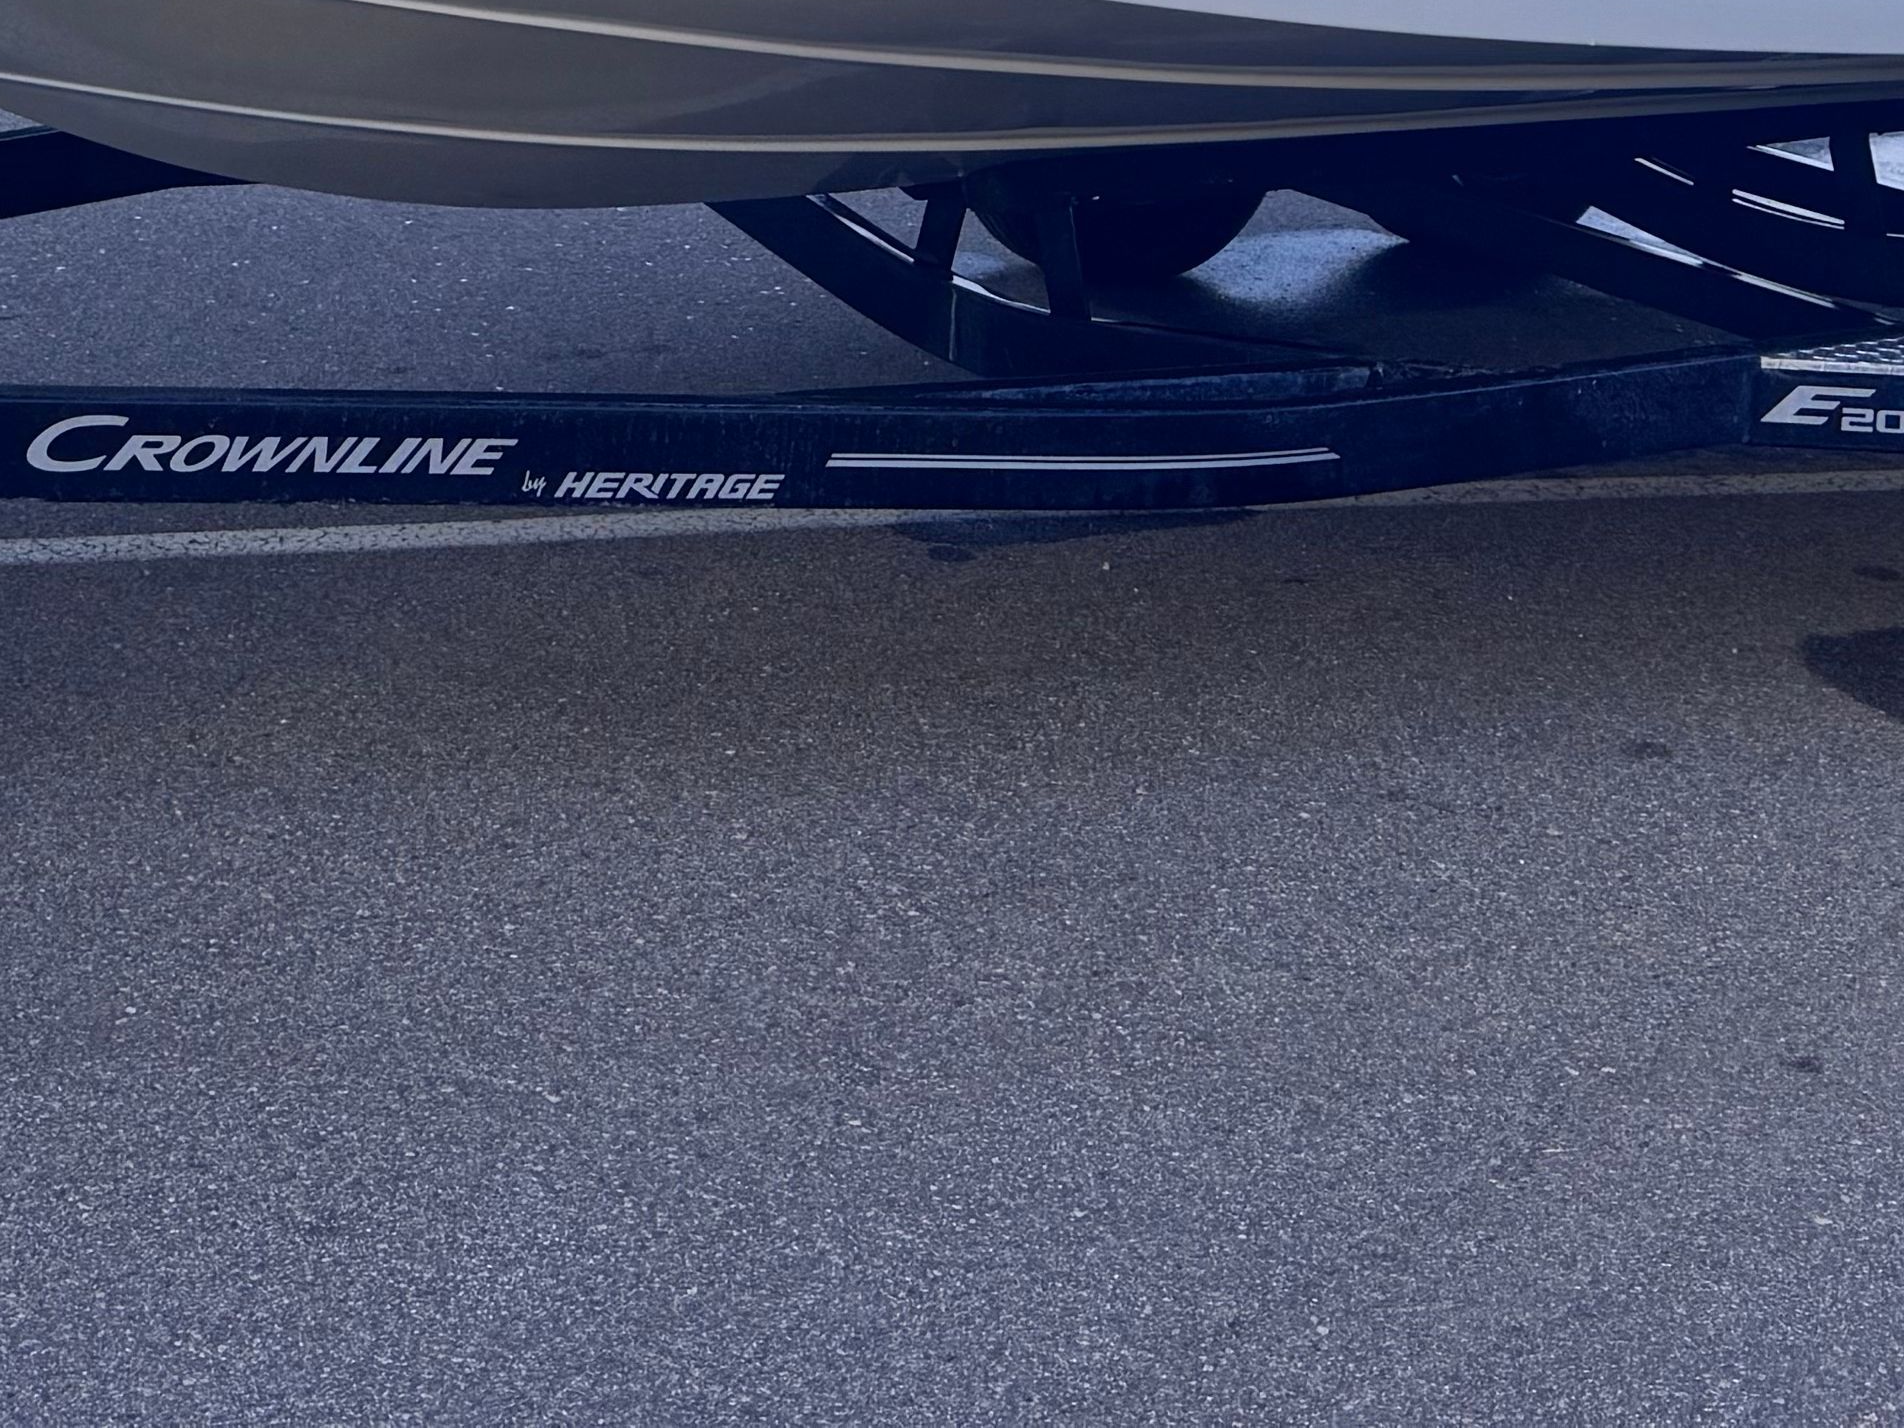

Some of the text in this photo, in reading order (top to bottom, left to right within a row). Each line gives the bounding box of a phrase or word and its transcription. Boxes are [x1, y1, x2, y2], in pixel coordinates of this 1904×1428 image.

[26, 414, 785, 500] CROWNLINE by HERITAGE
